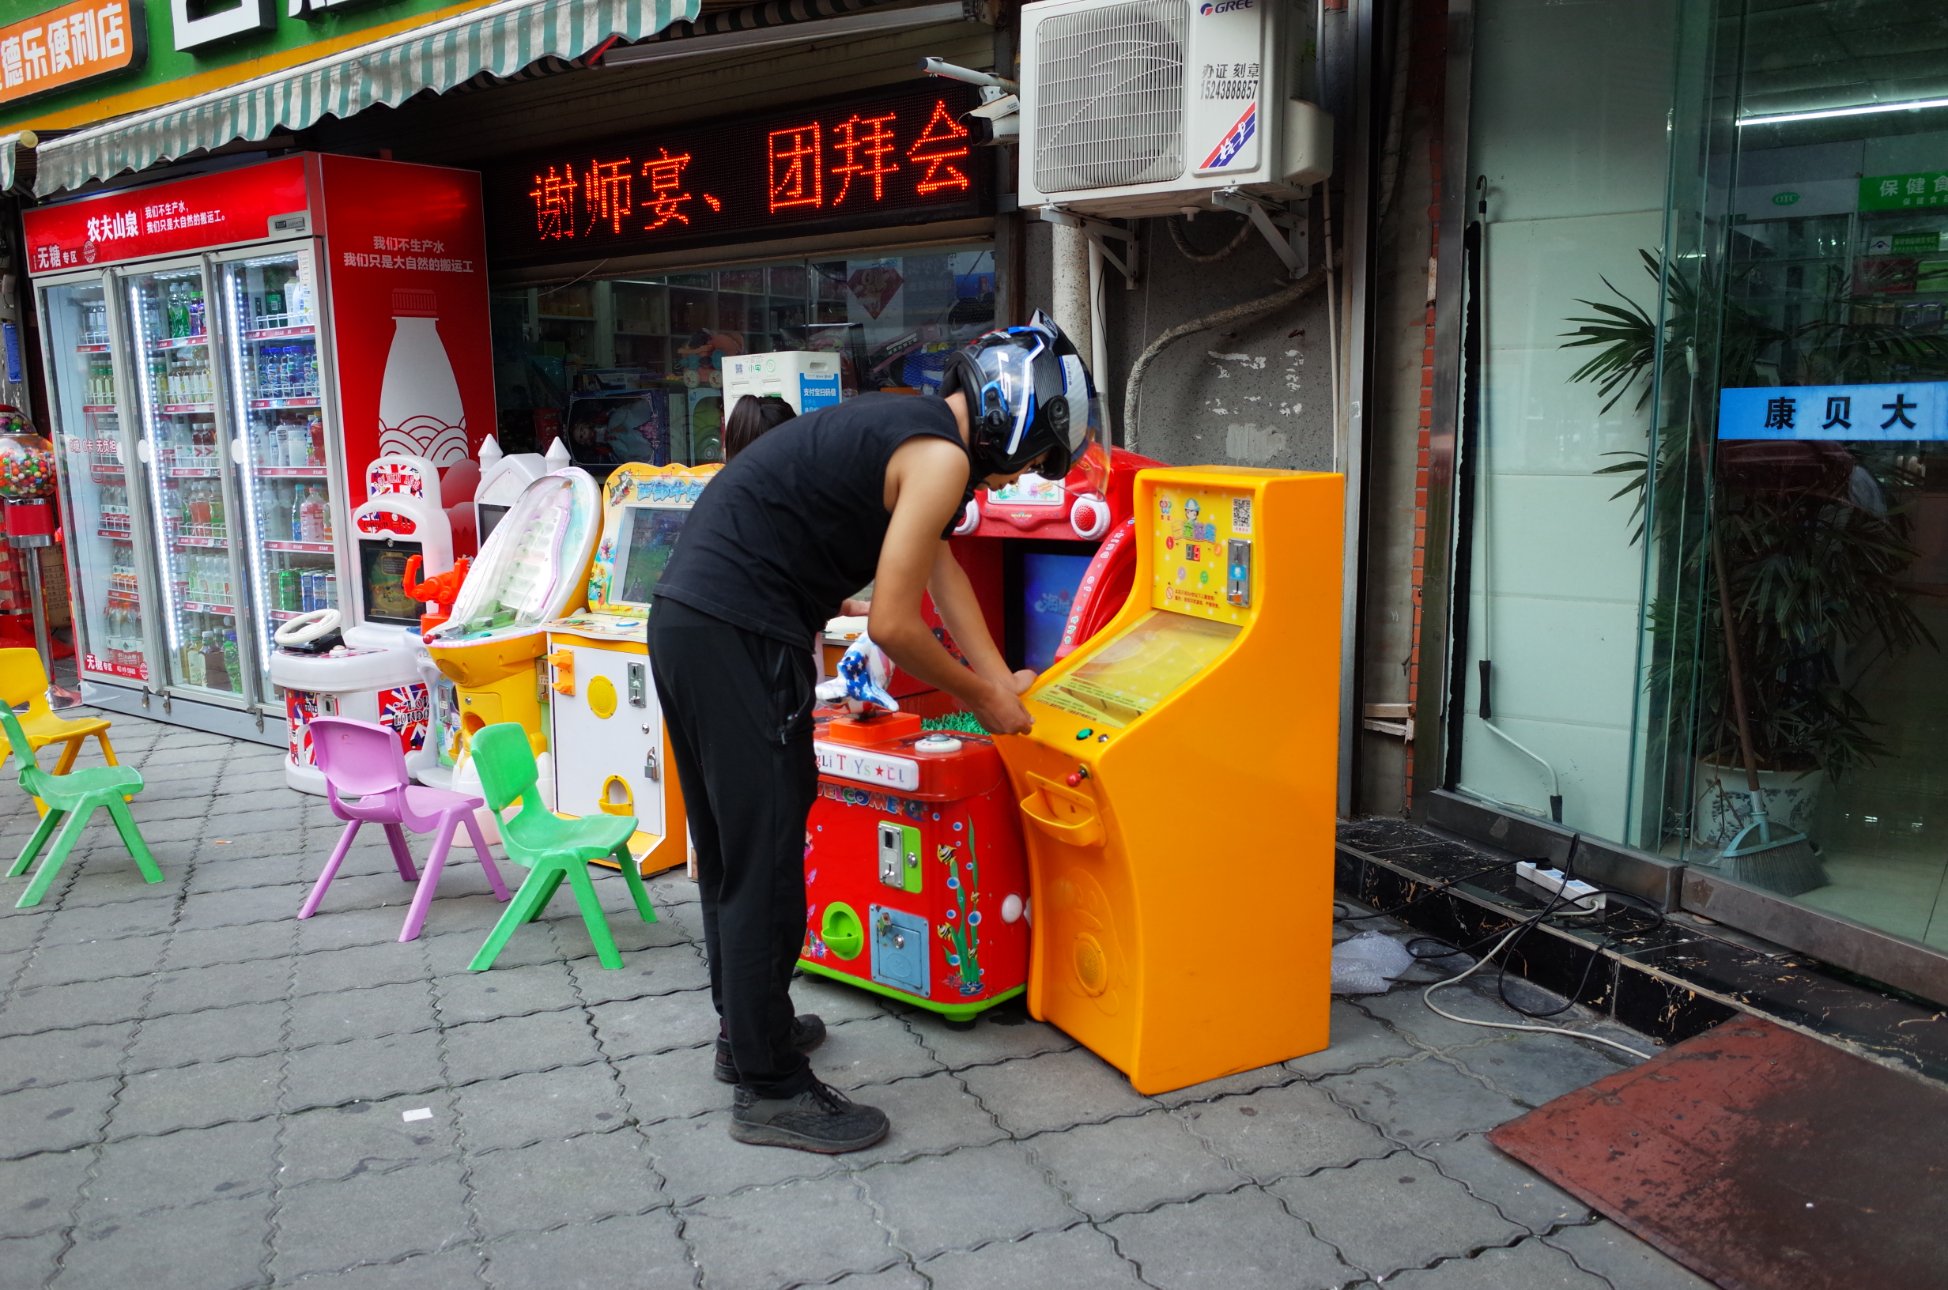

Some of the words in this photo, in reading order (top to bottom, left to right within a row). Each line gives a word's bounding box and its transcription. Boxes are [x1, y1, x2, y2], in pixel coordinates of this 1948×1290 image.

[1215, 0, 1254, 13] GREE
[1202, 63, 1228, 79] 办证
[1233, 63, 1260, 79] 刻章
[768, 100, 969, 215] 团拜会
[87, 210, 138, 242] 农夫山泉
[373, 235, 445, 253] 我们不生产水
[343, 251, 474, 273] 我们只是大自然的搬运工
[1764, 394, 1917, 430] 康贝大
